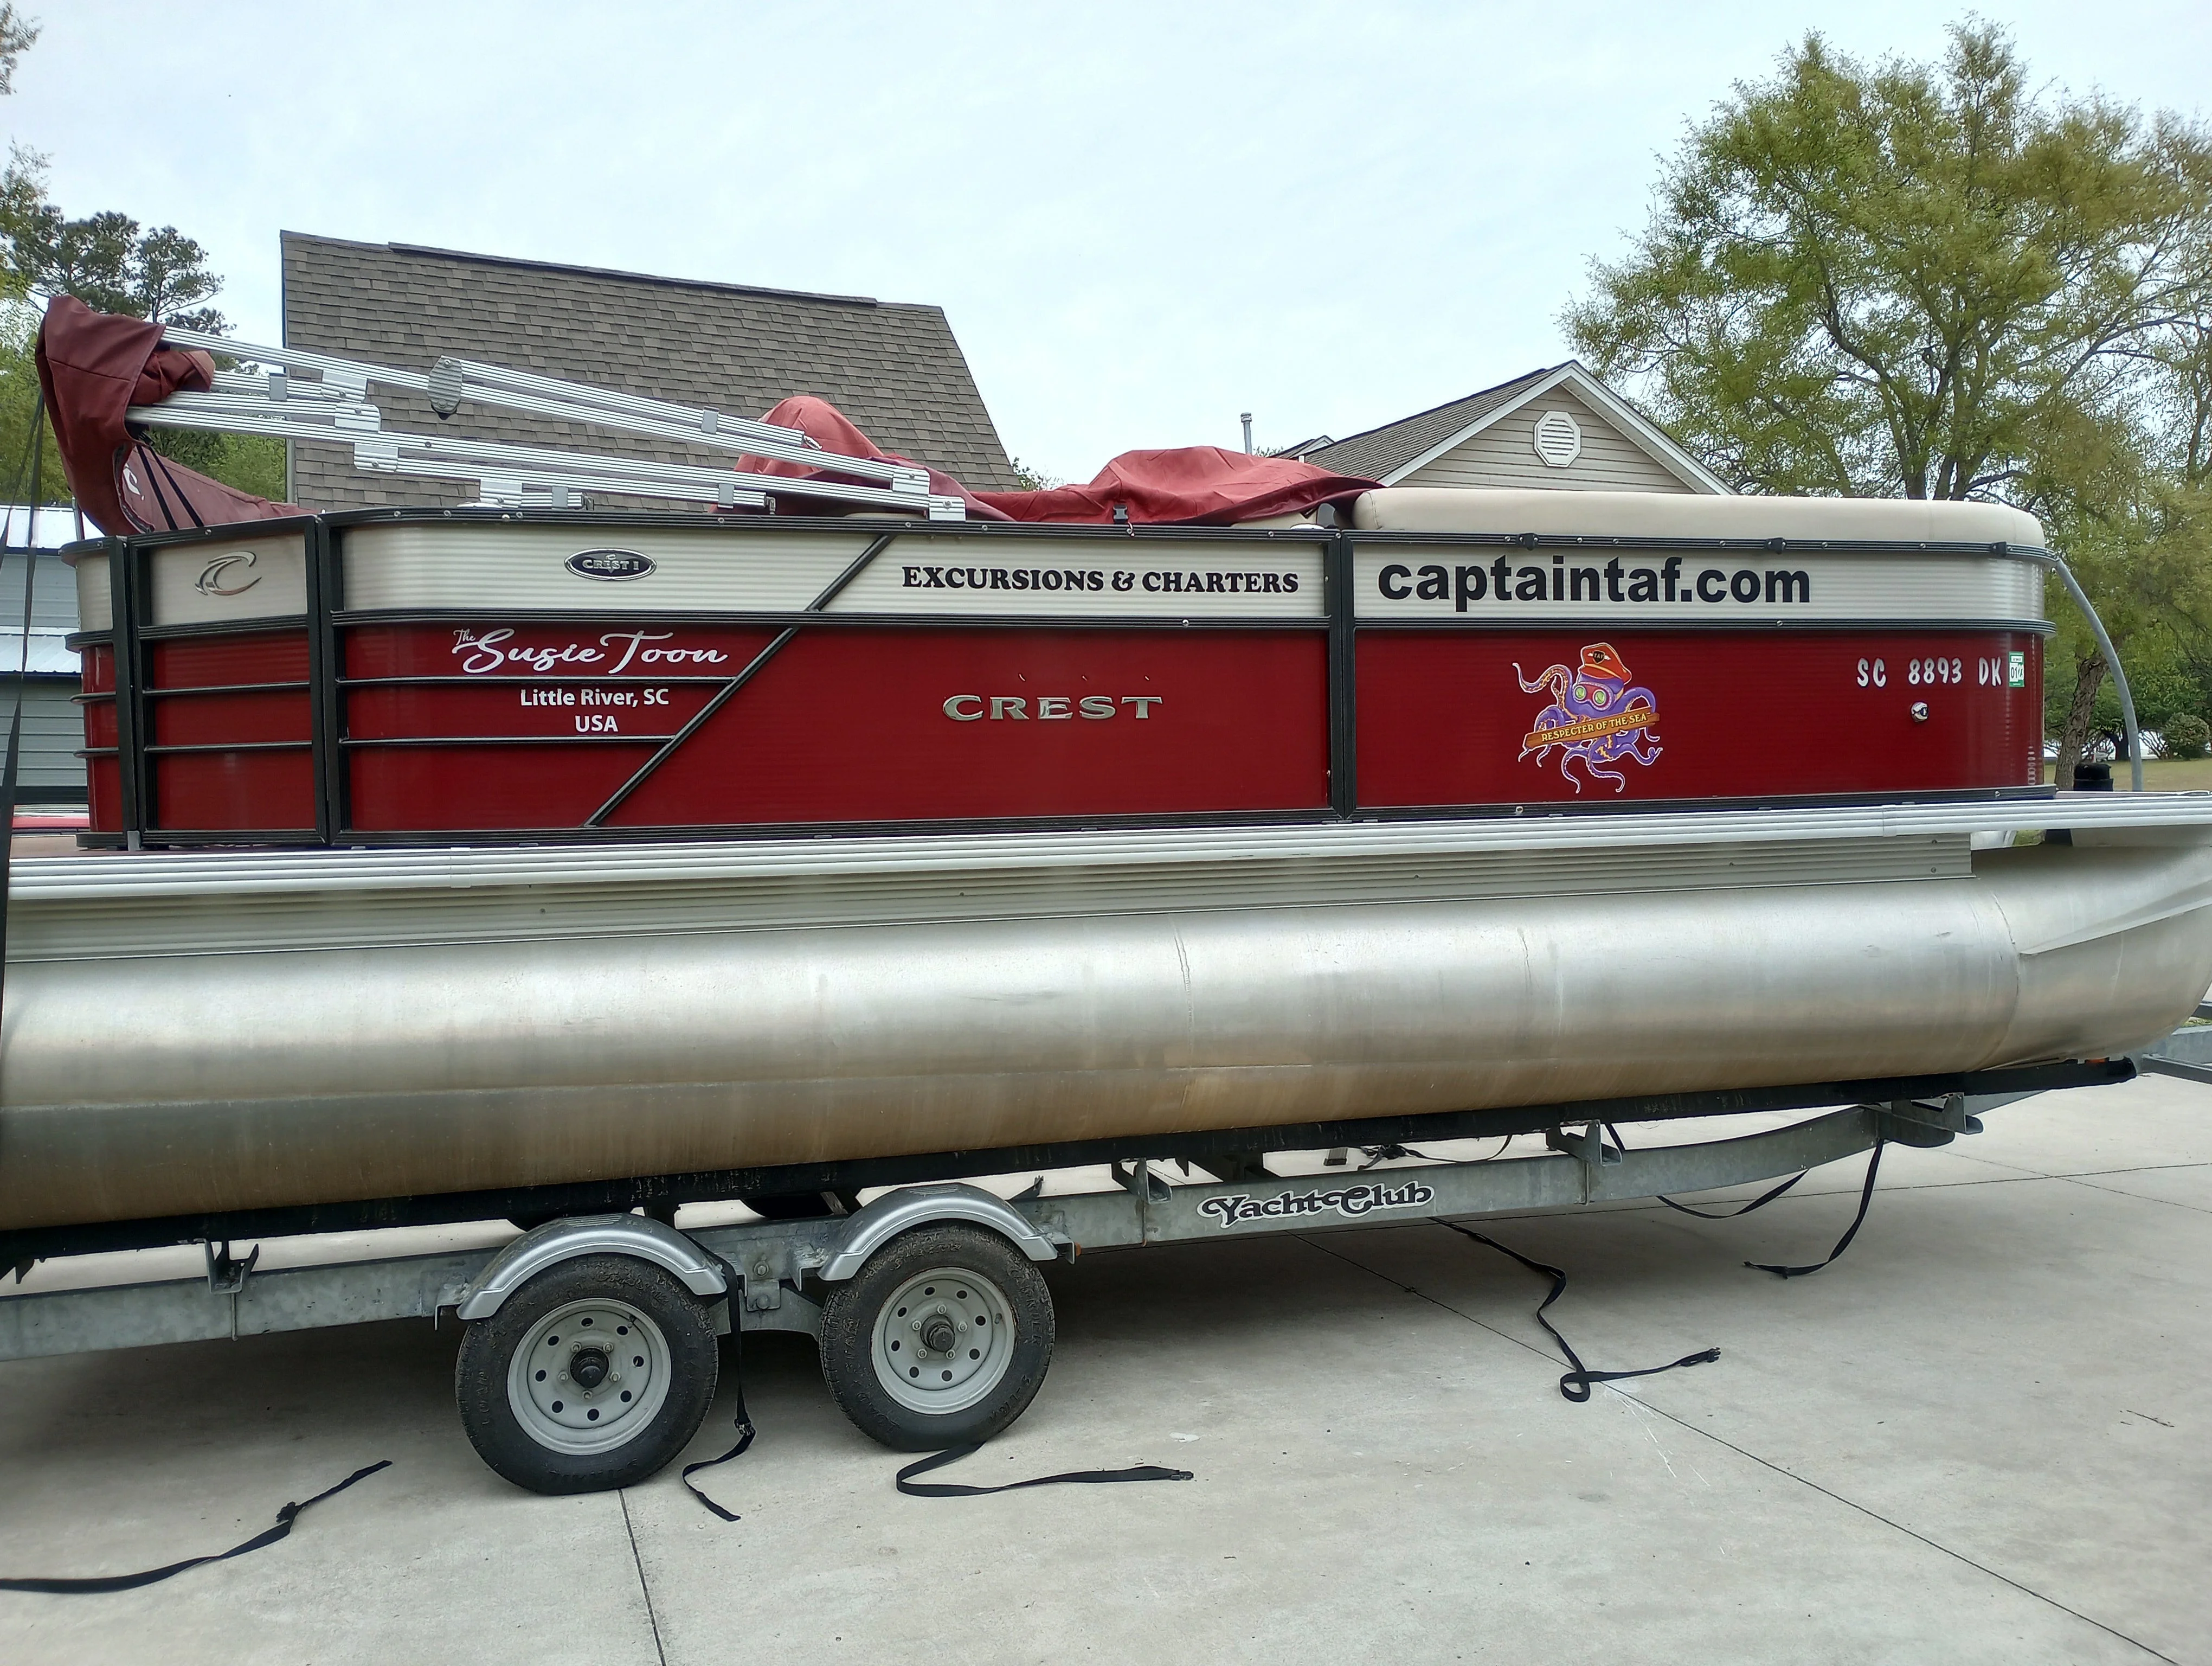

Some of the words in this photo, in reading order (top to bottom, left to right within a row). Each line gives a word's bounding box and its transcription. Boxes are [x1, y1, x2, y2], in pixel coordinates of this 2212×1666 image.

[582, 560, 629, 570] CREST
[902, 567, 1104, 591] EXCURSIONS
[1111, 571, 1135, 591] &
[1142, 572, 1299, 593] CHARTERS
[1378, 554, 1810, 612] captaintaf.com
[453, 629, 476, 646] The
[600, 630, 728, 674] Toon
[1857, 657, 1886, 687] SC
[1908, 657, 1962, 684] 8893
[1978, 656, 2001, 687] DK
[520, 688, 575, 706] Little
[581, 689, 638, 707] River,
[644, 688, 669, 705] SC
[942, 694, 1162, 721] CREST
[575, 715, 619, 732] USA
[1541, 723, 1594, 741] RESPECTER
[1596, 722, 1607, 731] OF
[1609, 717, 1627, 727] THE
[1629, 714, 1647, 724] SEA
[1201, 1190, 1324, 1226] Yacht
[1322, 1182, 1432, 1214] Club
